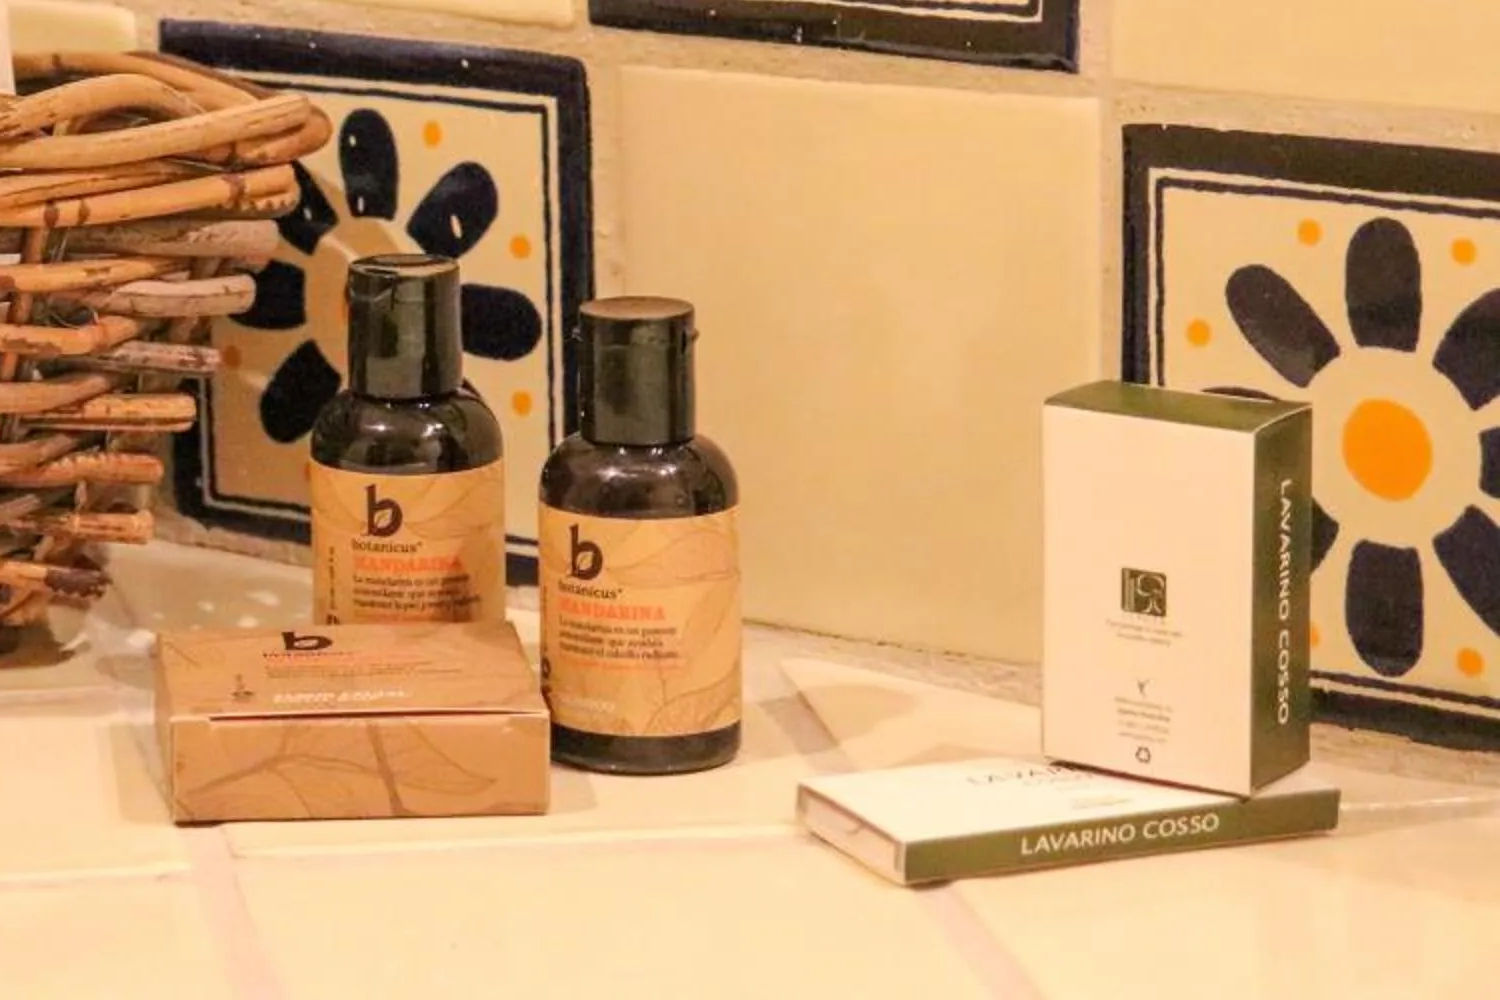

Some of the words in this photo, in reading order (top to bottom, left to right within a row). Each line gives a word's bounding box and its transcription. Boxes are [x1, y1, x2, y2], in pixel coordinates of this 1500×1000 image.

[1277, 478, 1293, 621] LAVARINO
[557, 596, 666, 621] MANDARINA
[1276, 629, 1291, 726] COSSO
[1020, 824, 1136, 856] LAVARINO
[1142, 813, 1220, 840] COSSO
